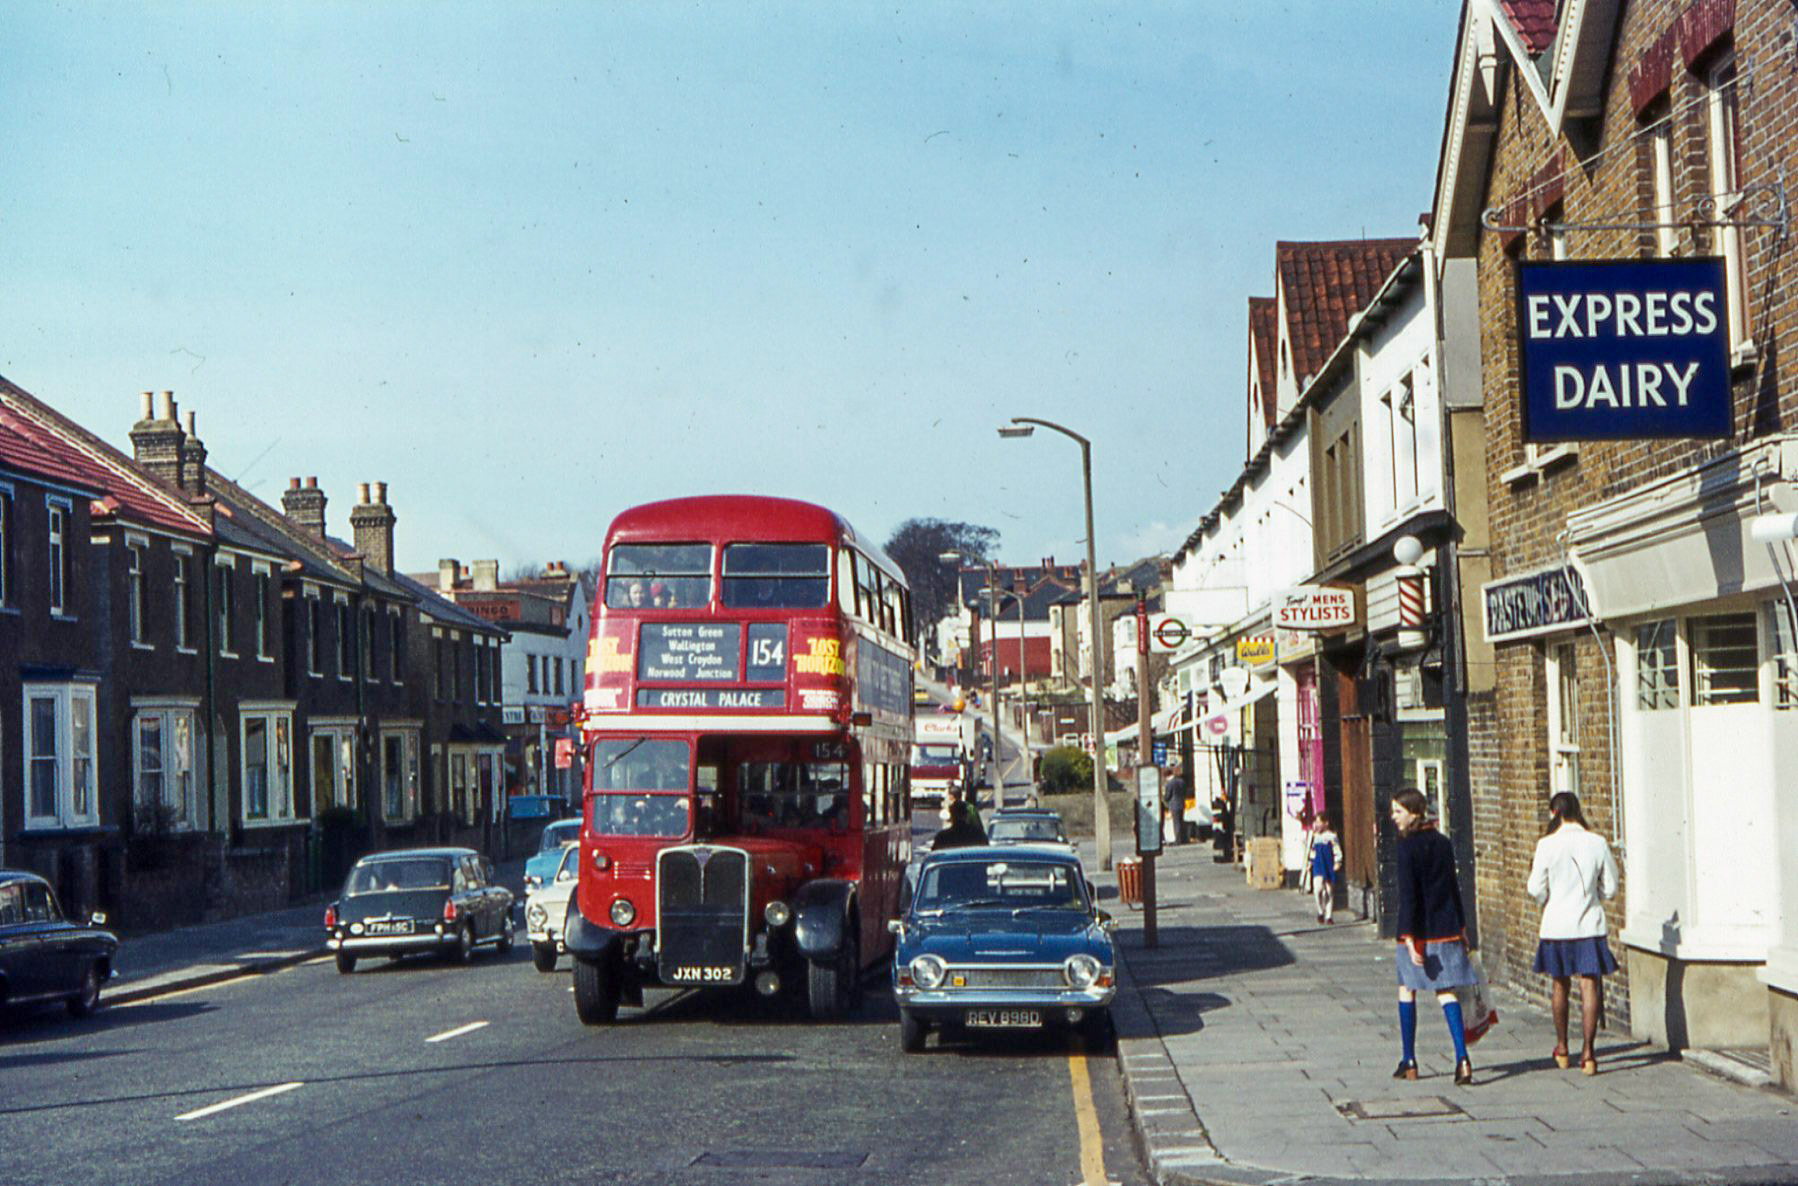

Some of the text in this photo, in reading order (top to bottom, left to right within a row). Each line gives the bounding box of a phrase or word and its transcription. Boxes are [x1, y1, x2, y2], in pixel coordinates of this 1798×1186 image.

[1528, 291, 1717, 339] EXPRESS
[1554, 362, 1699, 409] DAIRY
[1313, 594, 1345, 604] MENS
[1280, 606, 1350, 621] STYLISTS
[662, 625, 723, 637] Sutton Green
[668, 639, 716, 654] Wallington
[752, 638, 784, 666] 154
[661, 652, 723, 668] West Croydon
[647, 666, 733, 678] Norwood Junction
[660, 691, 762, 707] CRYSTAL PALACE
[816, 743, 844, 758] 154
[673, 966, 732, 980] JXN 302
[968, 1010, 996, 1024] REV
